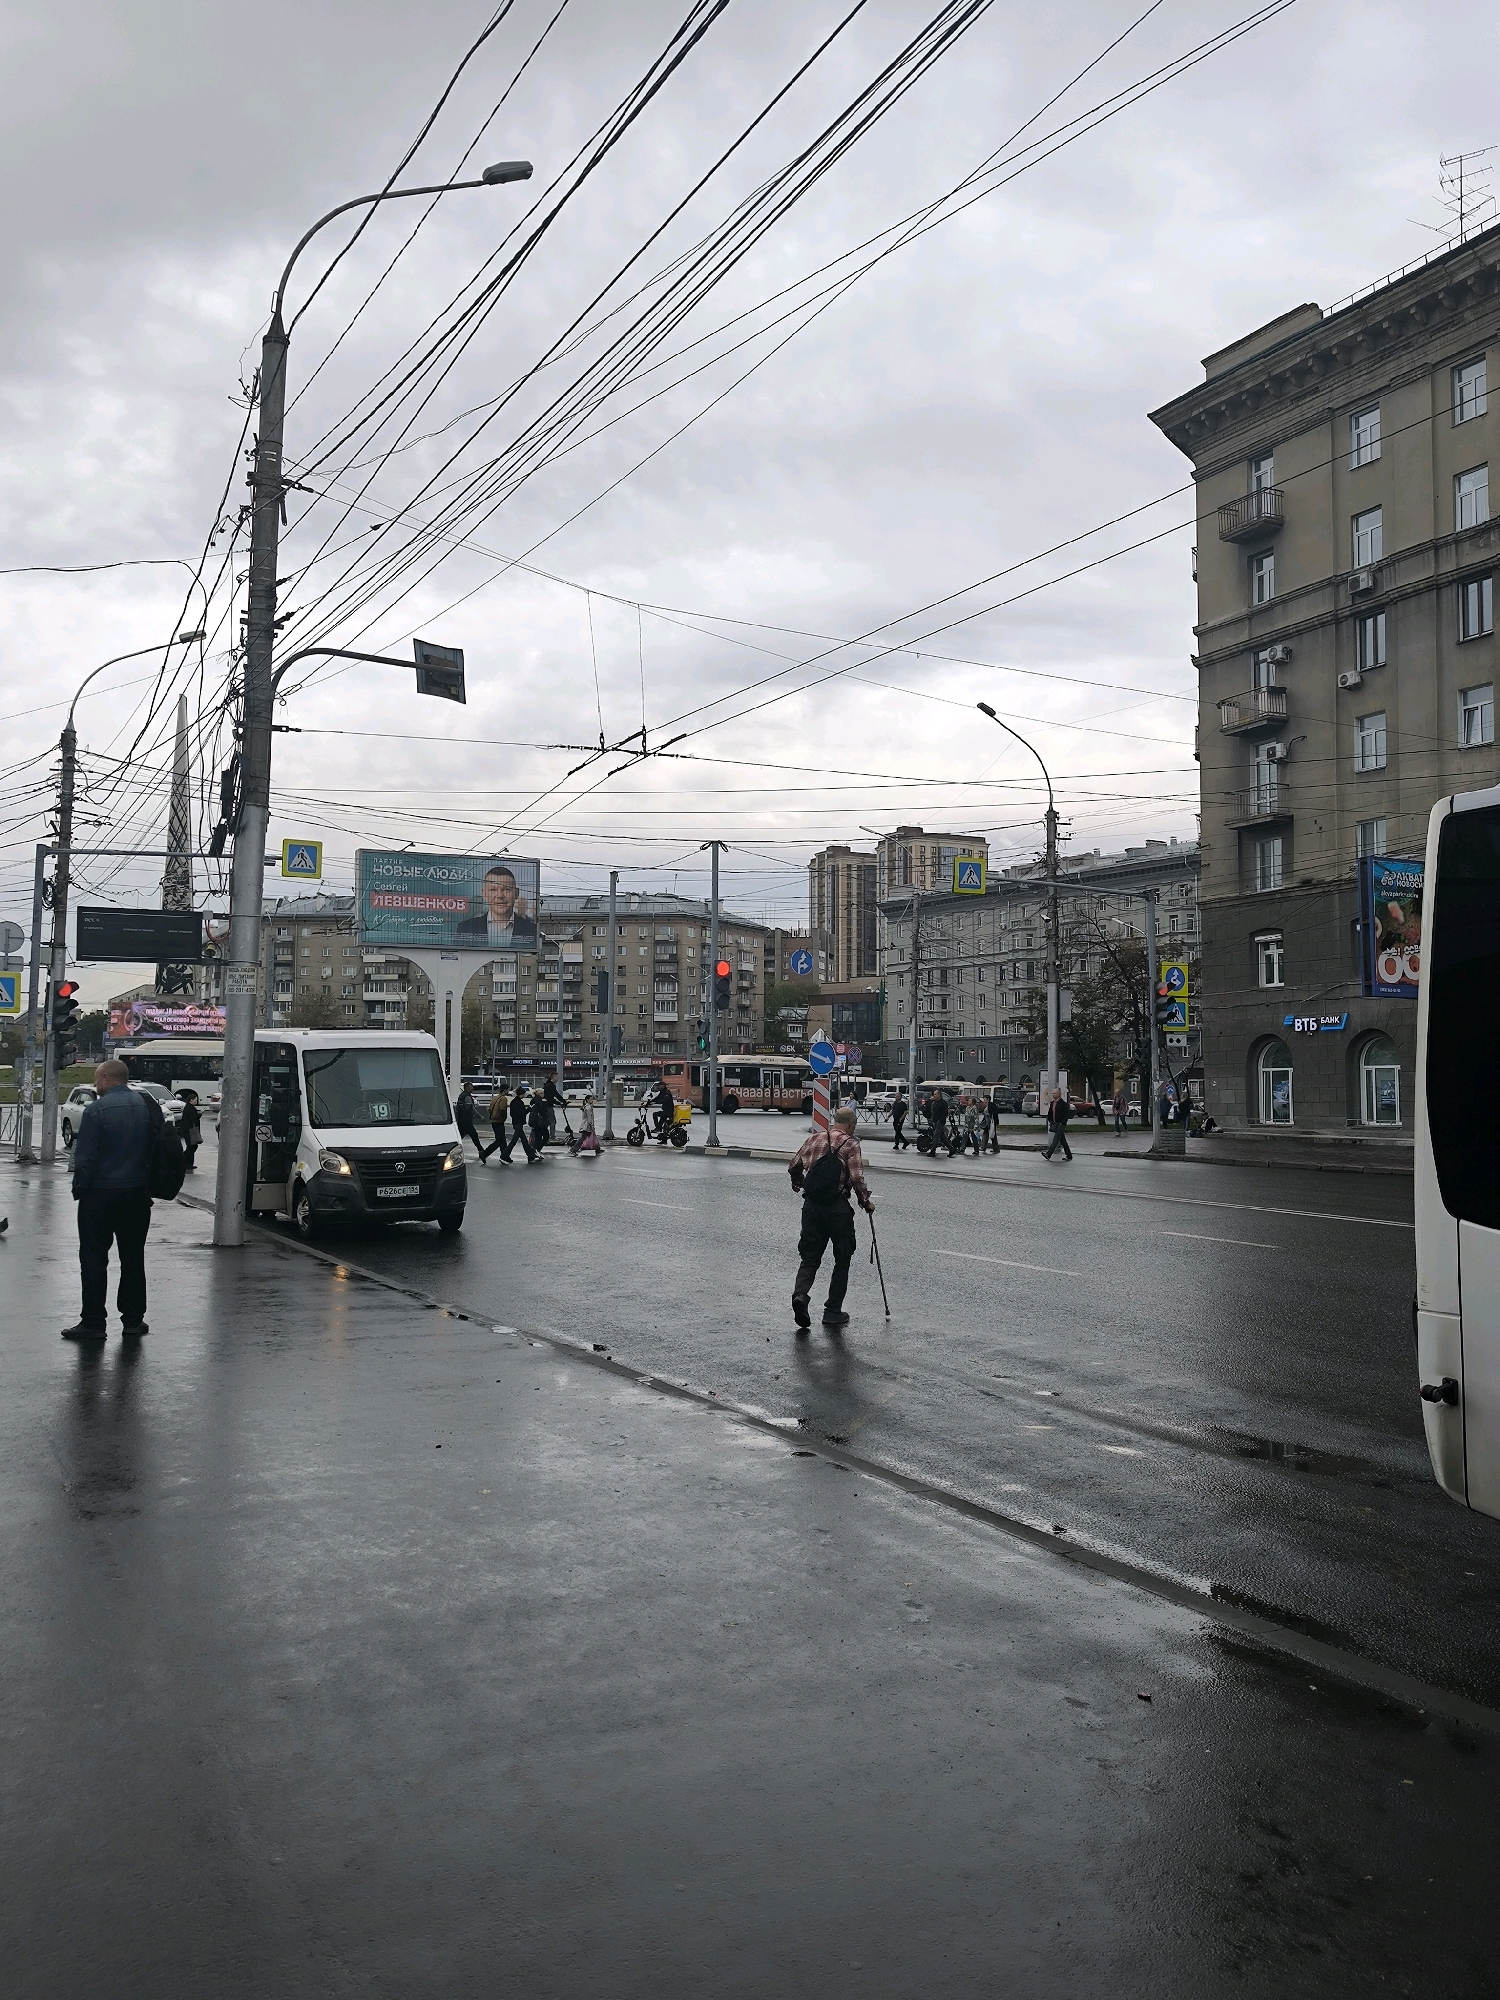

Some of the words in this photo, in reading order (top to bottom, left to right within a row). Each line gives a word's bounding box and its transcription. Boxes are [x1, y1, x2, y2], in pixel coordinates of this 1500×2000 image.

[373, 865, 424, 878] НОВЫЕ
[427, 868, 468, 880] ЛЮДИ
[373, 882, 408, 891] Сергей
[373, 895, 466, 910] ЛЕВШЕНКОВ
[1294, 1017, 1318, 1032] ВТБ
[1320, 1016, 1340, 1024] БАНК
[372, 1104, 388, 1117] 19
